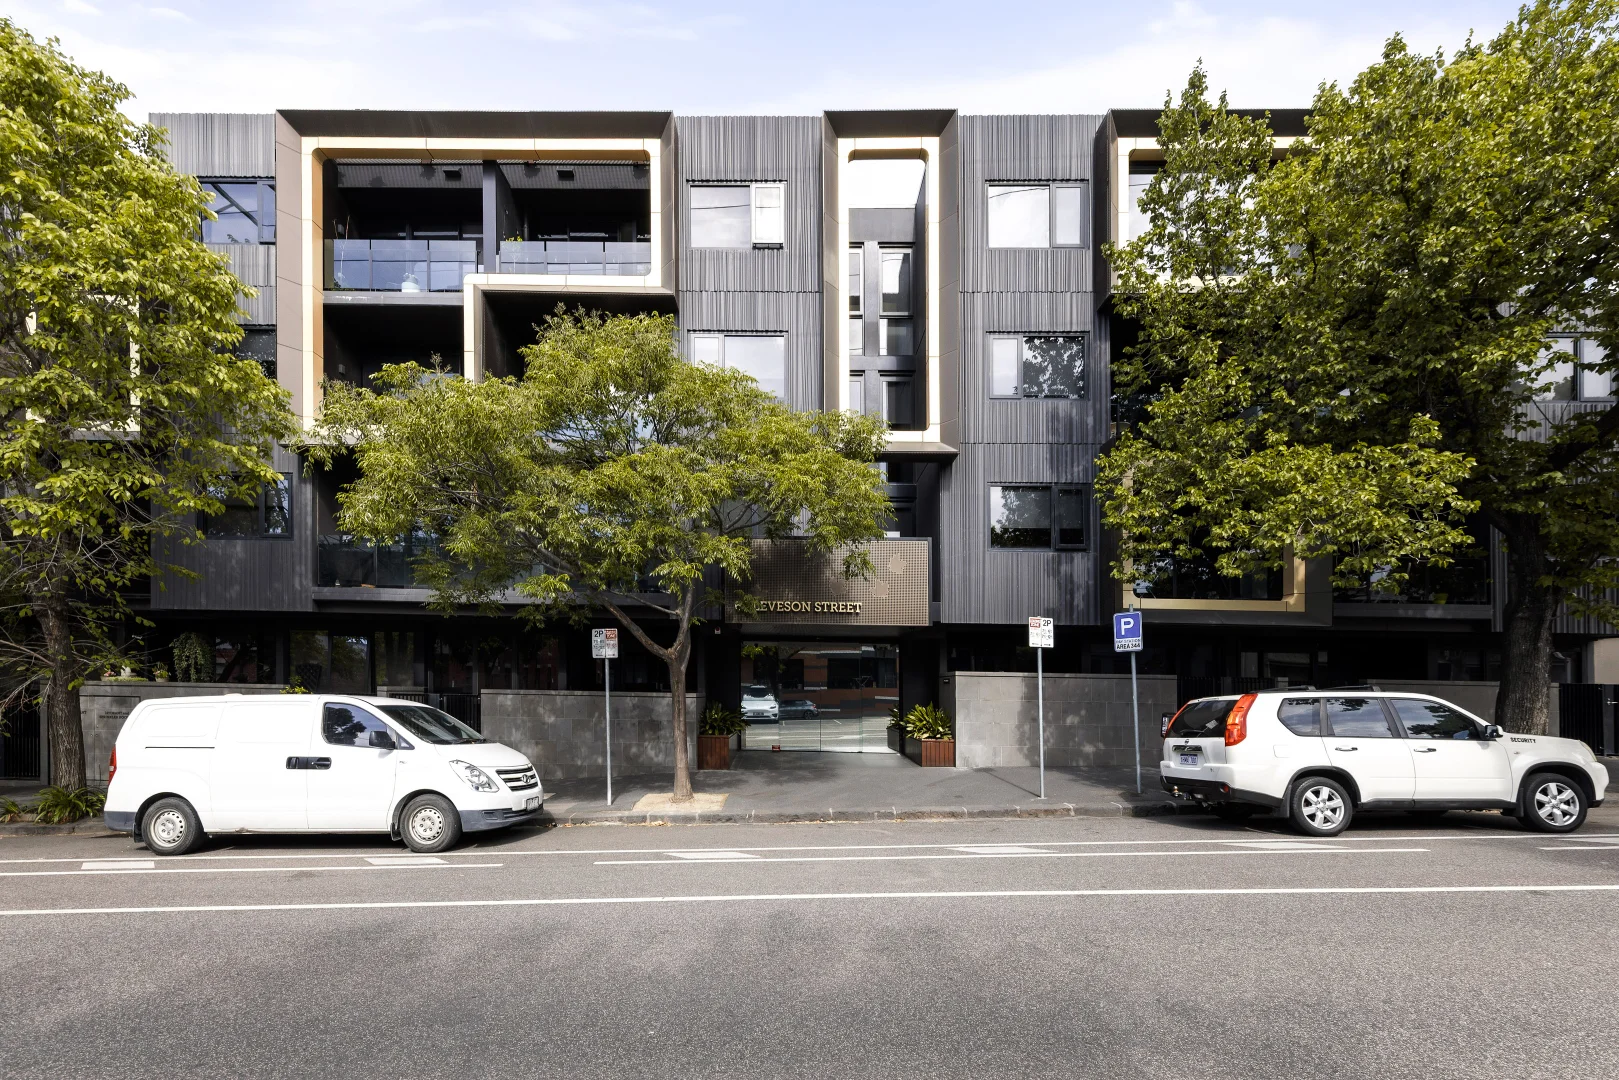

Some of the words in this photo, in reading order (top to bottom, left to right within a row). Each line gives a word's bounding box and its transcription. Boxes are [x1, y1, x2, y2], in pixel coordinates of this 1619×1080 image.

[814, 601, 862, 613] STREET
[1042, 619, 1052, 627] 2P
[1120, 617, 1135, 636] P
[594, 630, 604, 638] 2P
